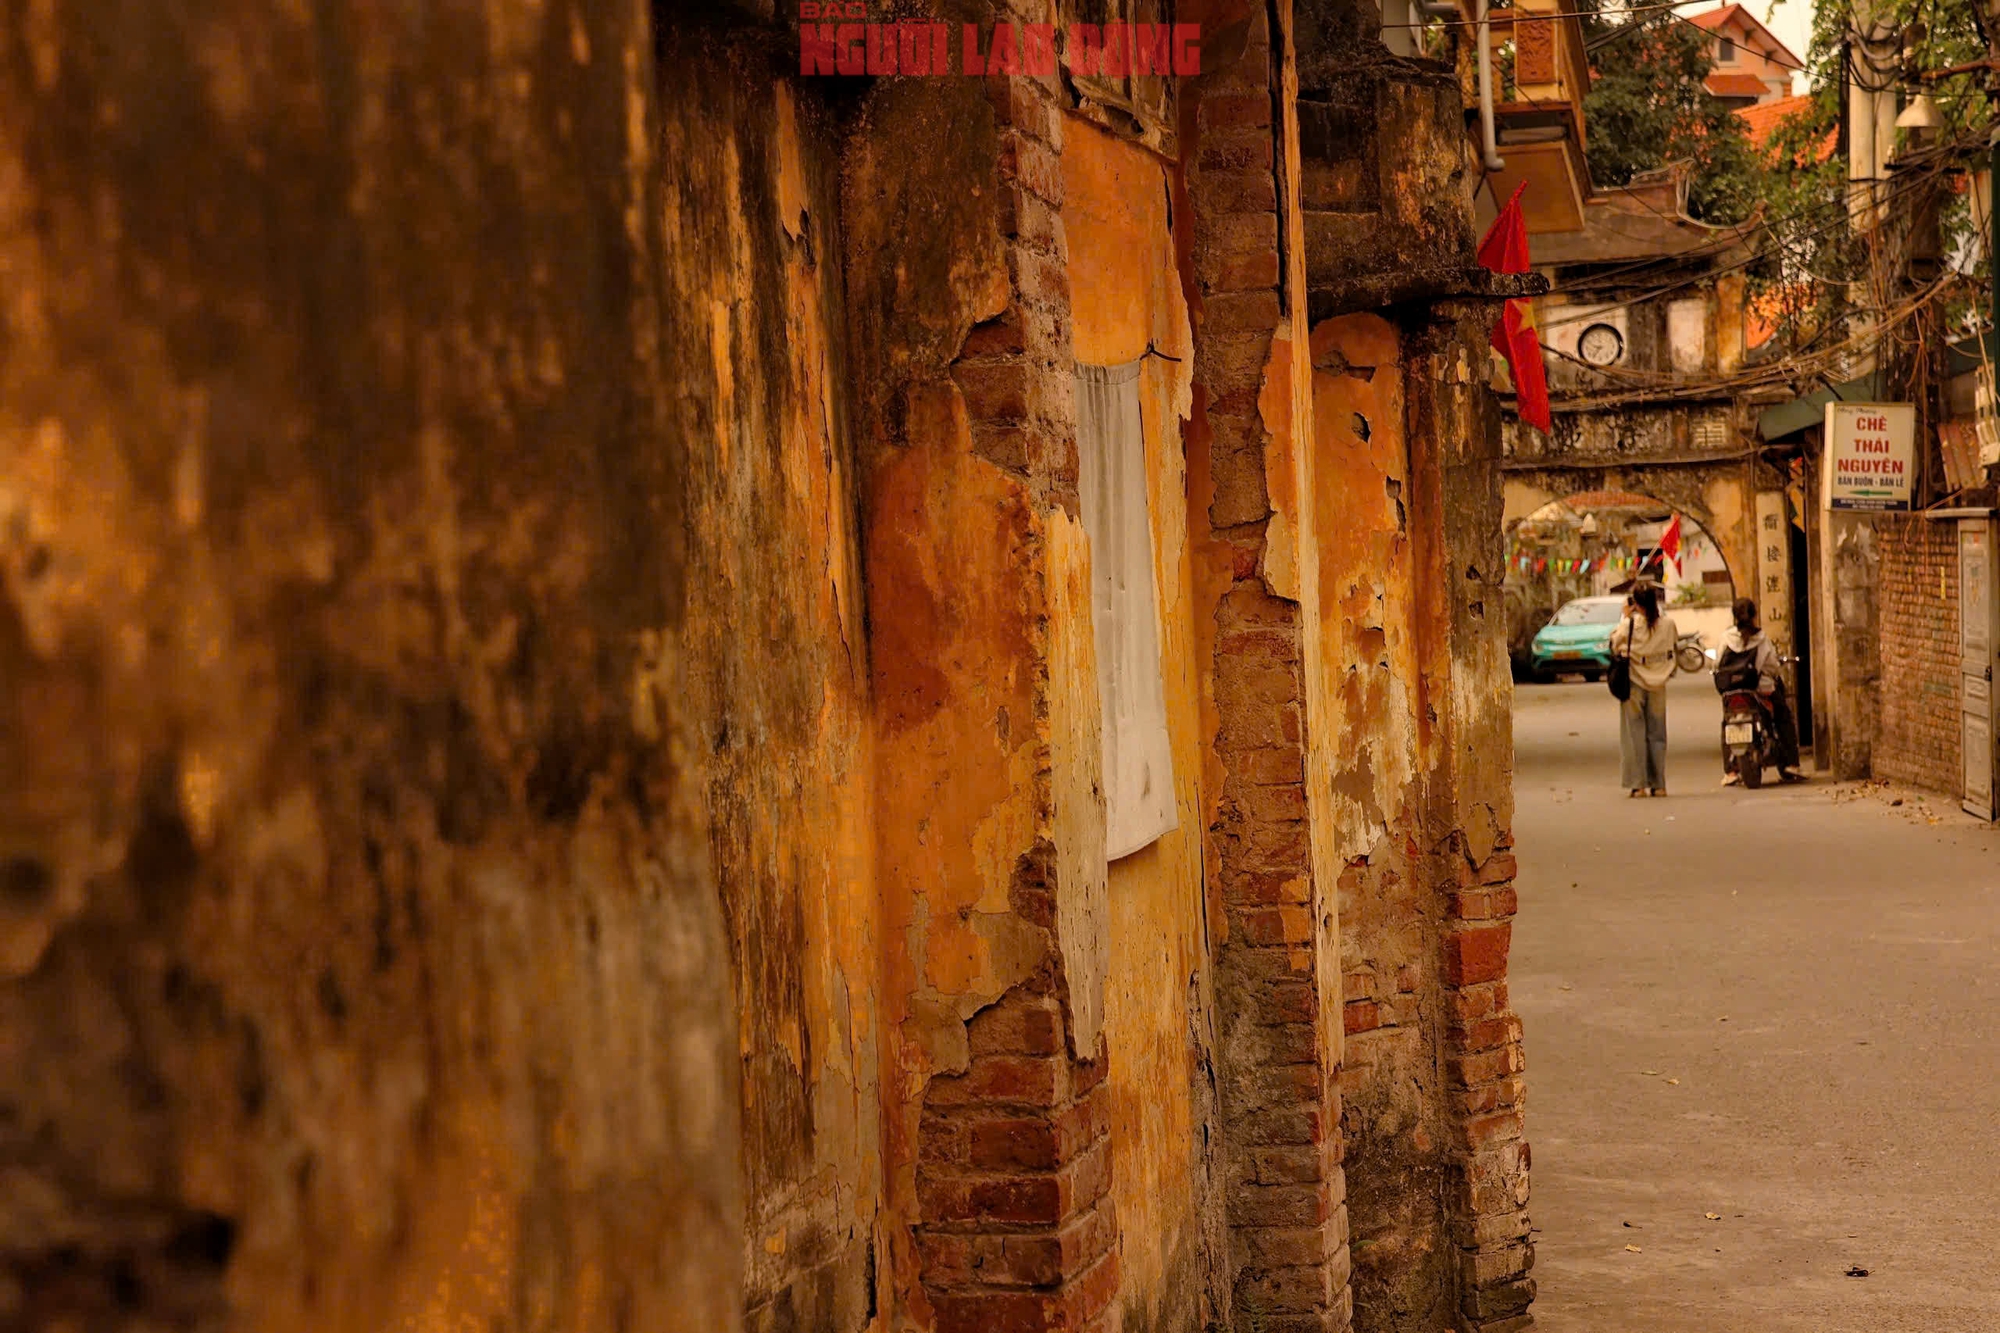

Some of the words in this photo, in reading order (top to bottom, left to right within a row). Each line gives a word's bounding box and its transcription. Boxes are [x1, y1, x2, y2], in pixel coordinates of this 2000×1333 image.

[1857, 415, 1887, 431] CHÈ
[1854, 437, 1889, 453] THÁI
[1838, 458, 1903, 473] NGUYÊN
